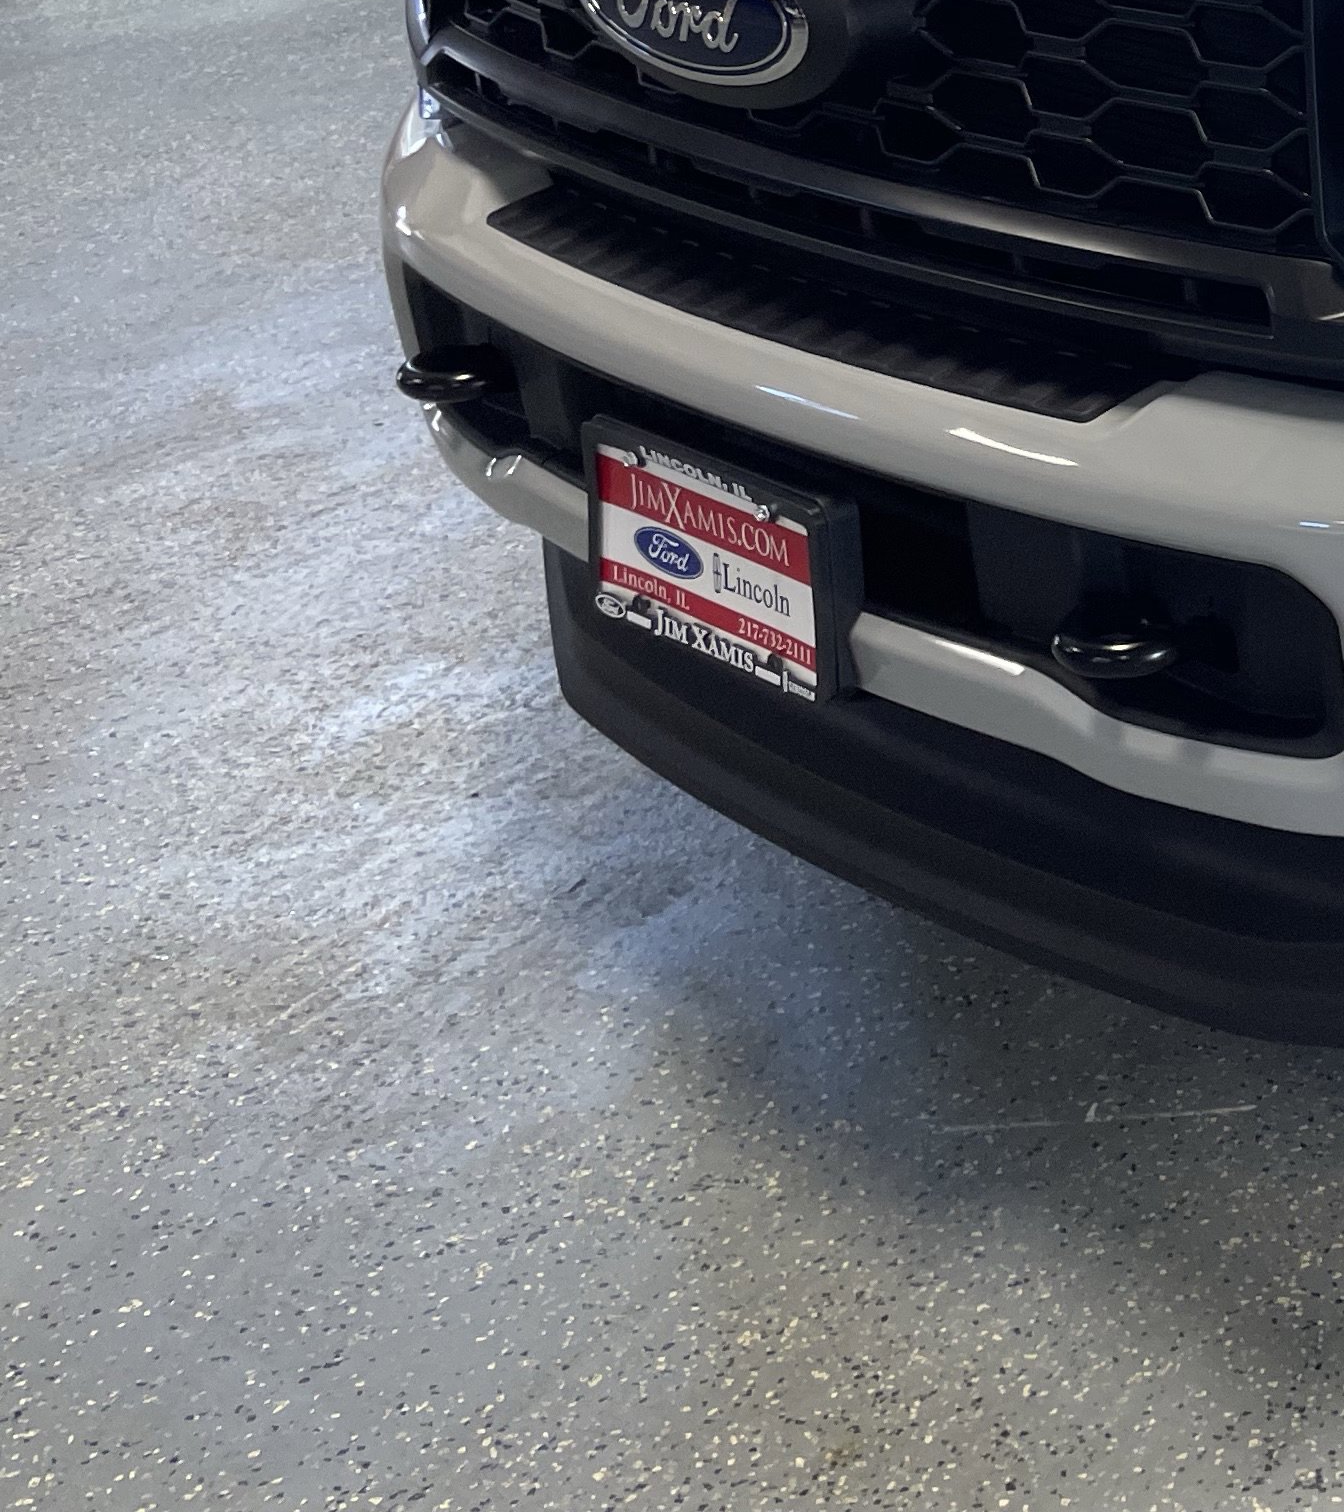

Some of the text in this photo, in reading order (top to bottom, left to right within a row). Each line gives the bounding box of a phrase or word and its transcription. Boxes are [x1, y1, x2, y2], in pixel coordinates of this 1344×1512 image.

[649, 533, 690, 574] Ford
[612, 565, 690, 610] Lincoln, IL
[722, 563, 791, 618] Lincoln
[654, 607, 755, 673] JIM XAMIS
[738, 617, 811, 666] 217-732-2111
